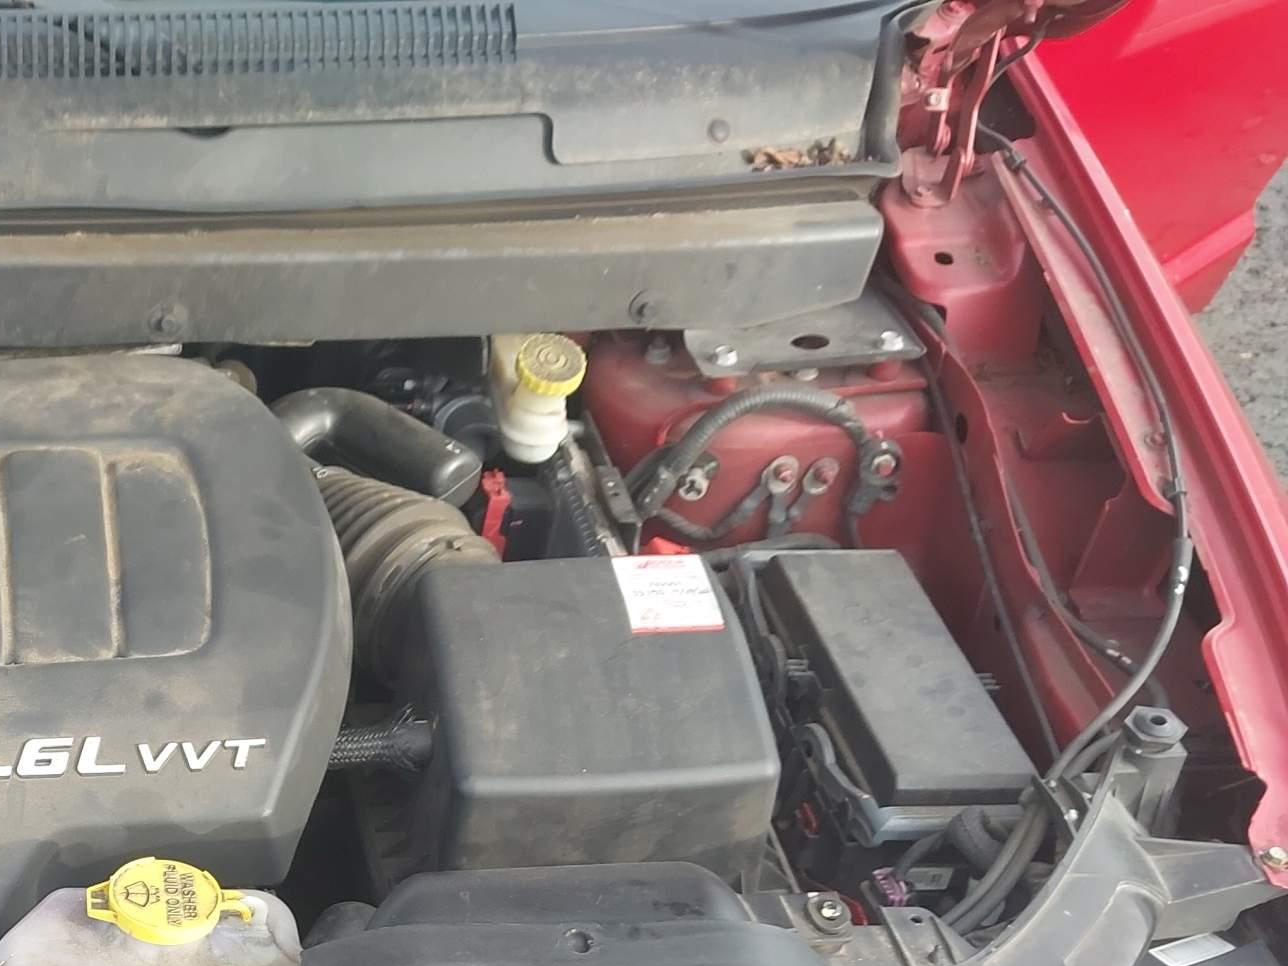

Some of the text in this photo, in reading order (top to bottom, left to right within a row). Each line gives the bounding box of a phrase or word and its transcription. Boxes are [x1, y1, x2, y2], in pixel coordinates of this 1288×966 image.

[136, 738, 266, 774] VVT
[163, 863, 183, 927] FLUID ONLY
[179, 872, 198, 920] WASHER
